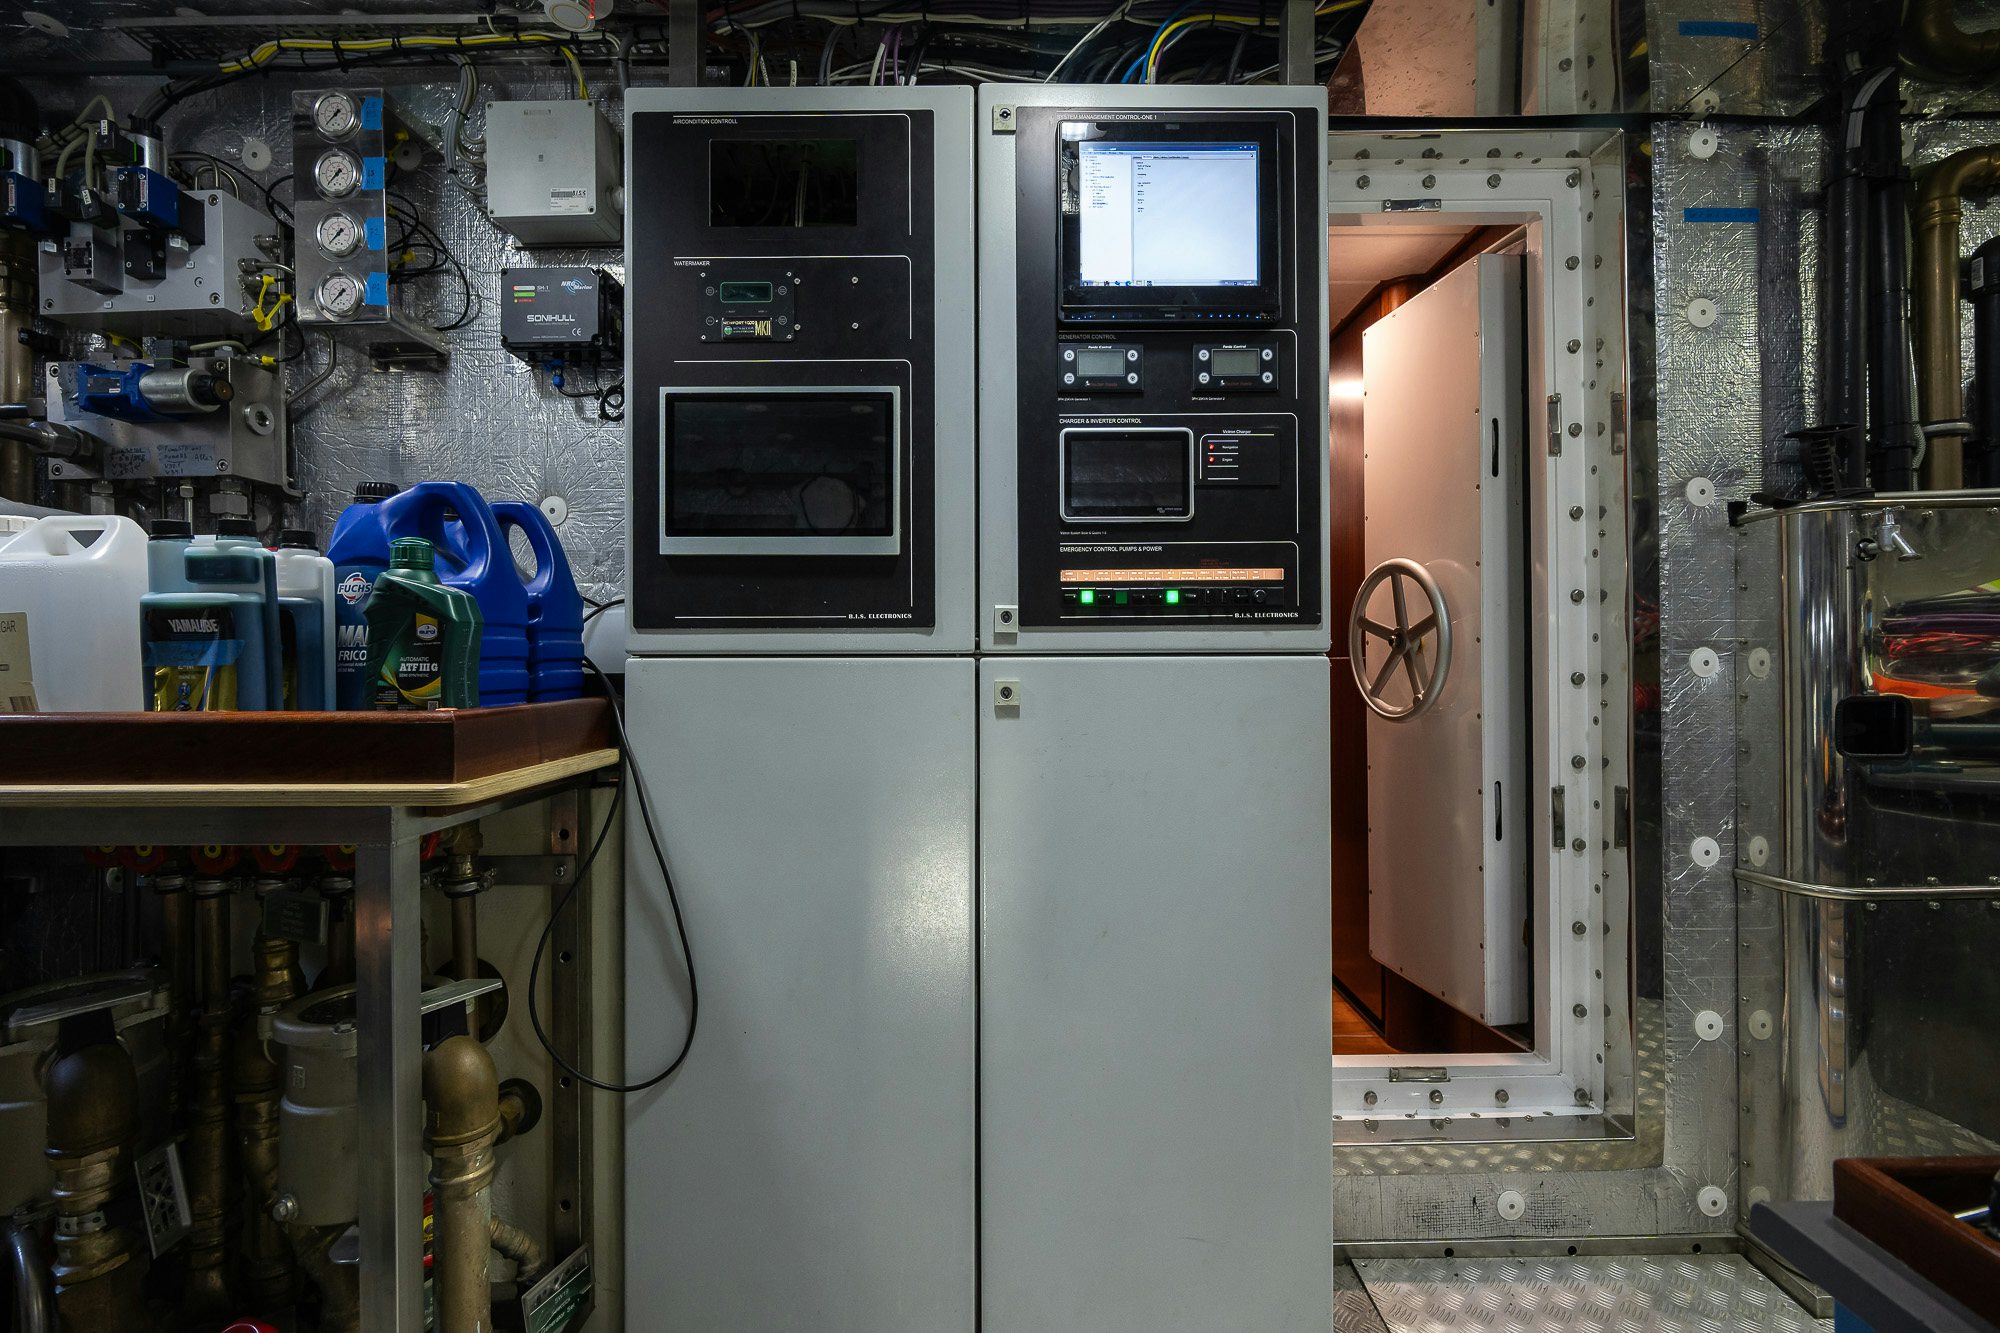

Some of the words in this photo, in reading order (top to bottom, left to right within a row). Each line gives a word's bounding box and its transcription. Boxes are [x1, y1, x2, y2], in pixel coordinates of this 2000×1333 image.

[526, 314, 576, 322] SONIHULL
[755, 320, 771, 336] MKII
[337, 583, 372, 595] FUCHS
[0, 619, 17, 633] GAR
[168, 618, 220, 633] YAMALUBE
[399, 663, 419, 672] ATF
[419, 663, 430, 672] III
[430, 663, 439, 672] G
